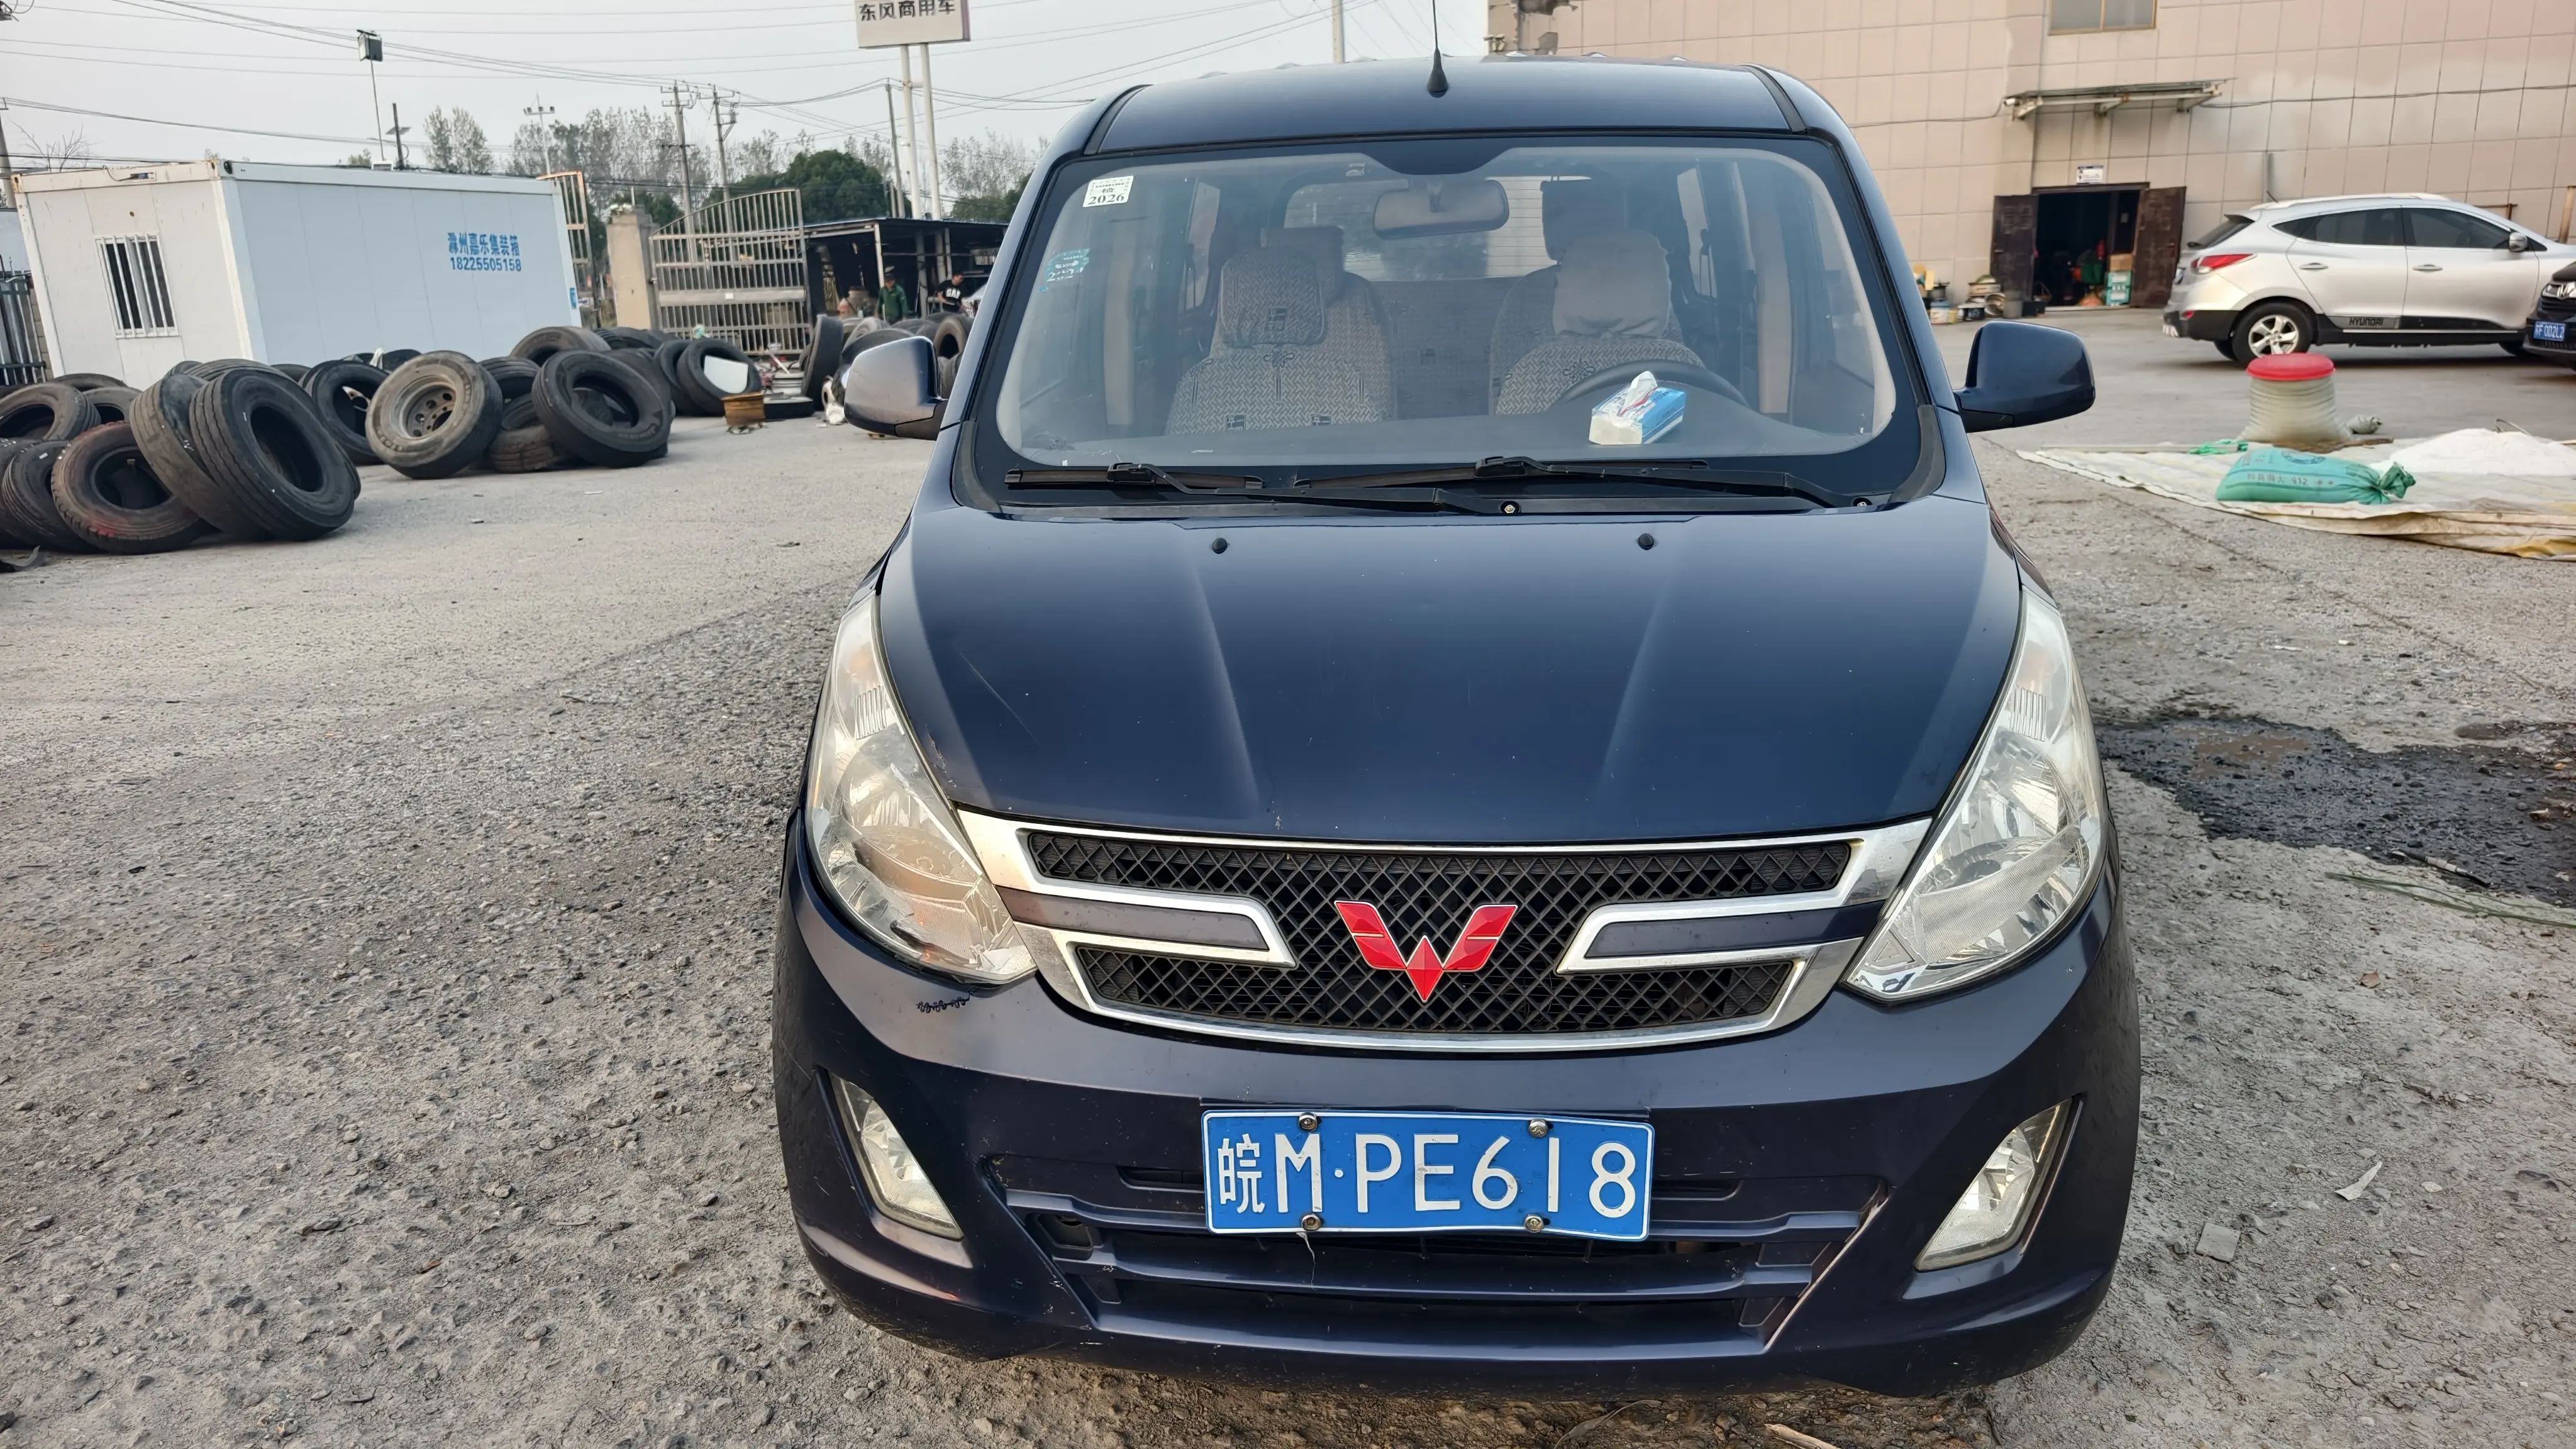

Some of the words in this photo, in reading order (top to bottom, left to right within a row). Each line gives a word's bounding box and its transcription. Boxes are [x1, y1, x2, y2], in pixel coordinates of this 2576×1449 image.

[859, 0, 956, 21] 东风商用车
[1087, 193, 1126, 205] 2026
[450, 257, 522, 272] 18225505158
[2349, 317, 2384, 326] HYUNDAI
[1218, 1132, 1636, 1218] 皖M·PE618
